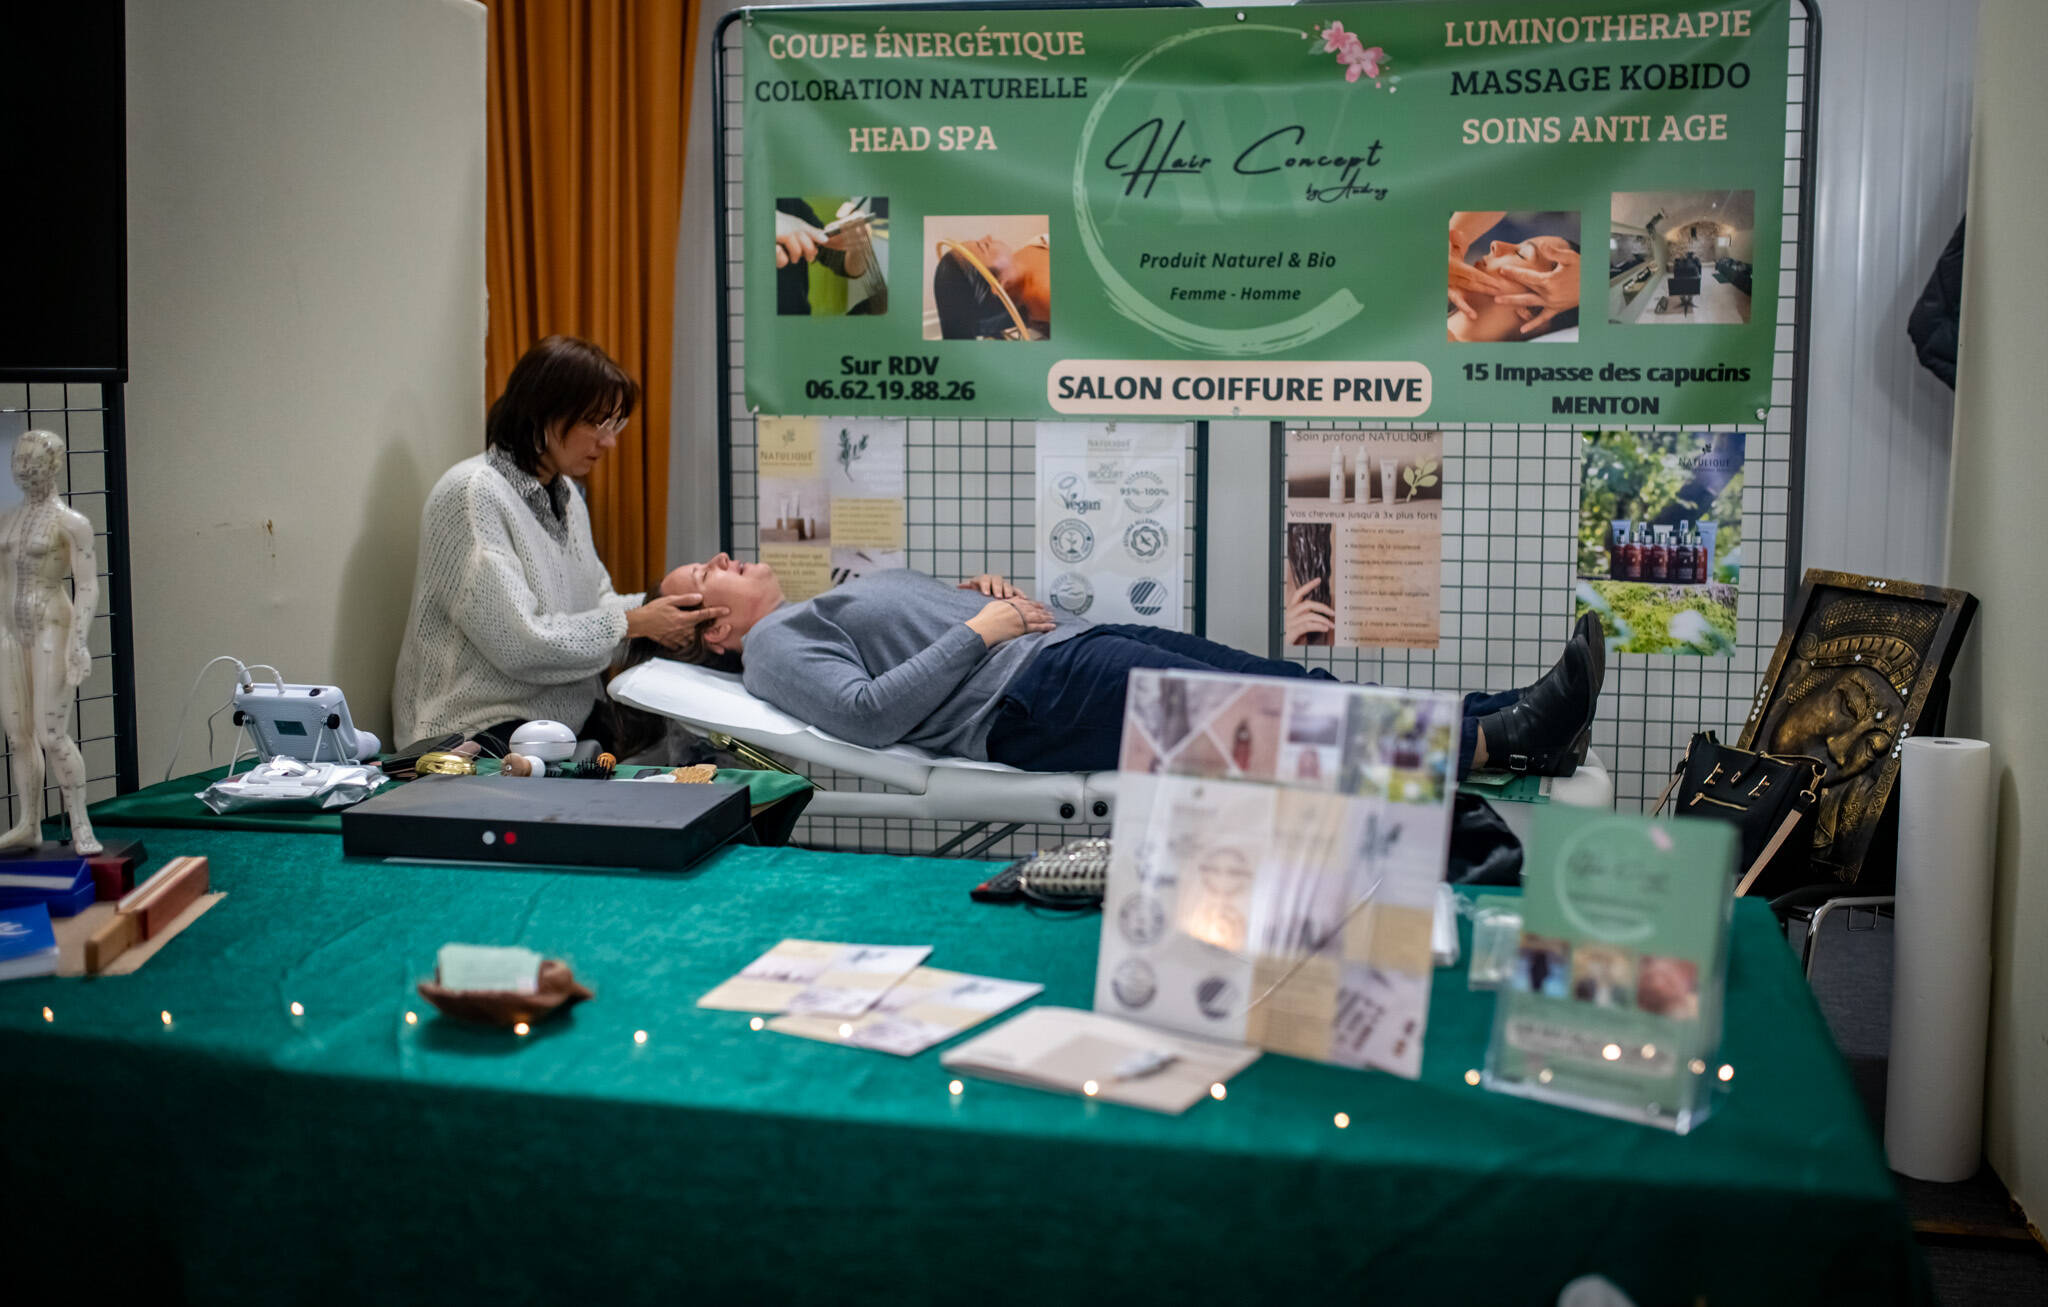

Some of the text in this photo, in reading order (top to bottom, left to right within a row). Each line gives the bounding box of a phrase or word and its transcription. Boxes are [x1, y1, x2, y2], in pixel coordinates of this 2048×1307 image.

[1444, 10, 1751, 48] LUMINOTHERAPIE
[768, 26, 1086, 61] COUPE ÉNERGÉTIQUE
[755, 77, 1088, 103] COLORATION NATURELLE
[1449, 62, 1751, 96] MASSAGE KOBIDO
[849, 126, 998, 153] HEAD SPA
[1462, 113, 1728, 145] SOINS ANTI AGE
[1104, 118, 1383, 199] Hair Concept
[1139, 252, 1337, 269] Produit Naturel & Bio
[1170, 287, 1227, 301] Femme
[1240, 287, 1302, 301] Homme
[840, 356, 940, 376] Sur RDV
[1462, 362, 1751, 388] 15 Impasse des capucins
[805, 380, 976, 401] 06.62.19.88.26
[1057, 375, 1422, 402] SALON COIFFURE PRIVE
[1551, 396, 1660, 415] MENTON
[1296, 431, 1434, 443] Soin profond NATULIQUE
[1289, 510, 1306, 519] Vos
[1308, 509, 1345, 519] cheveux
[1395, 509, 1414, 520] plus
[1416, 510, 1438, 521] forts
